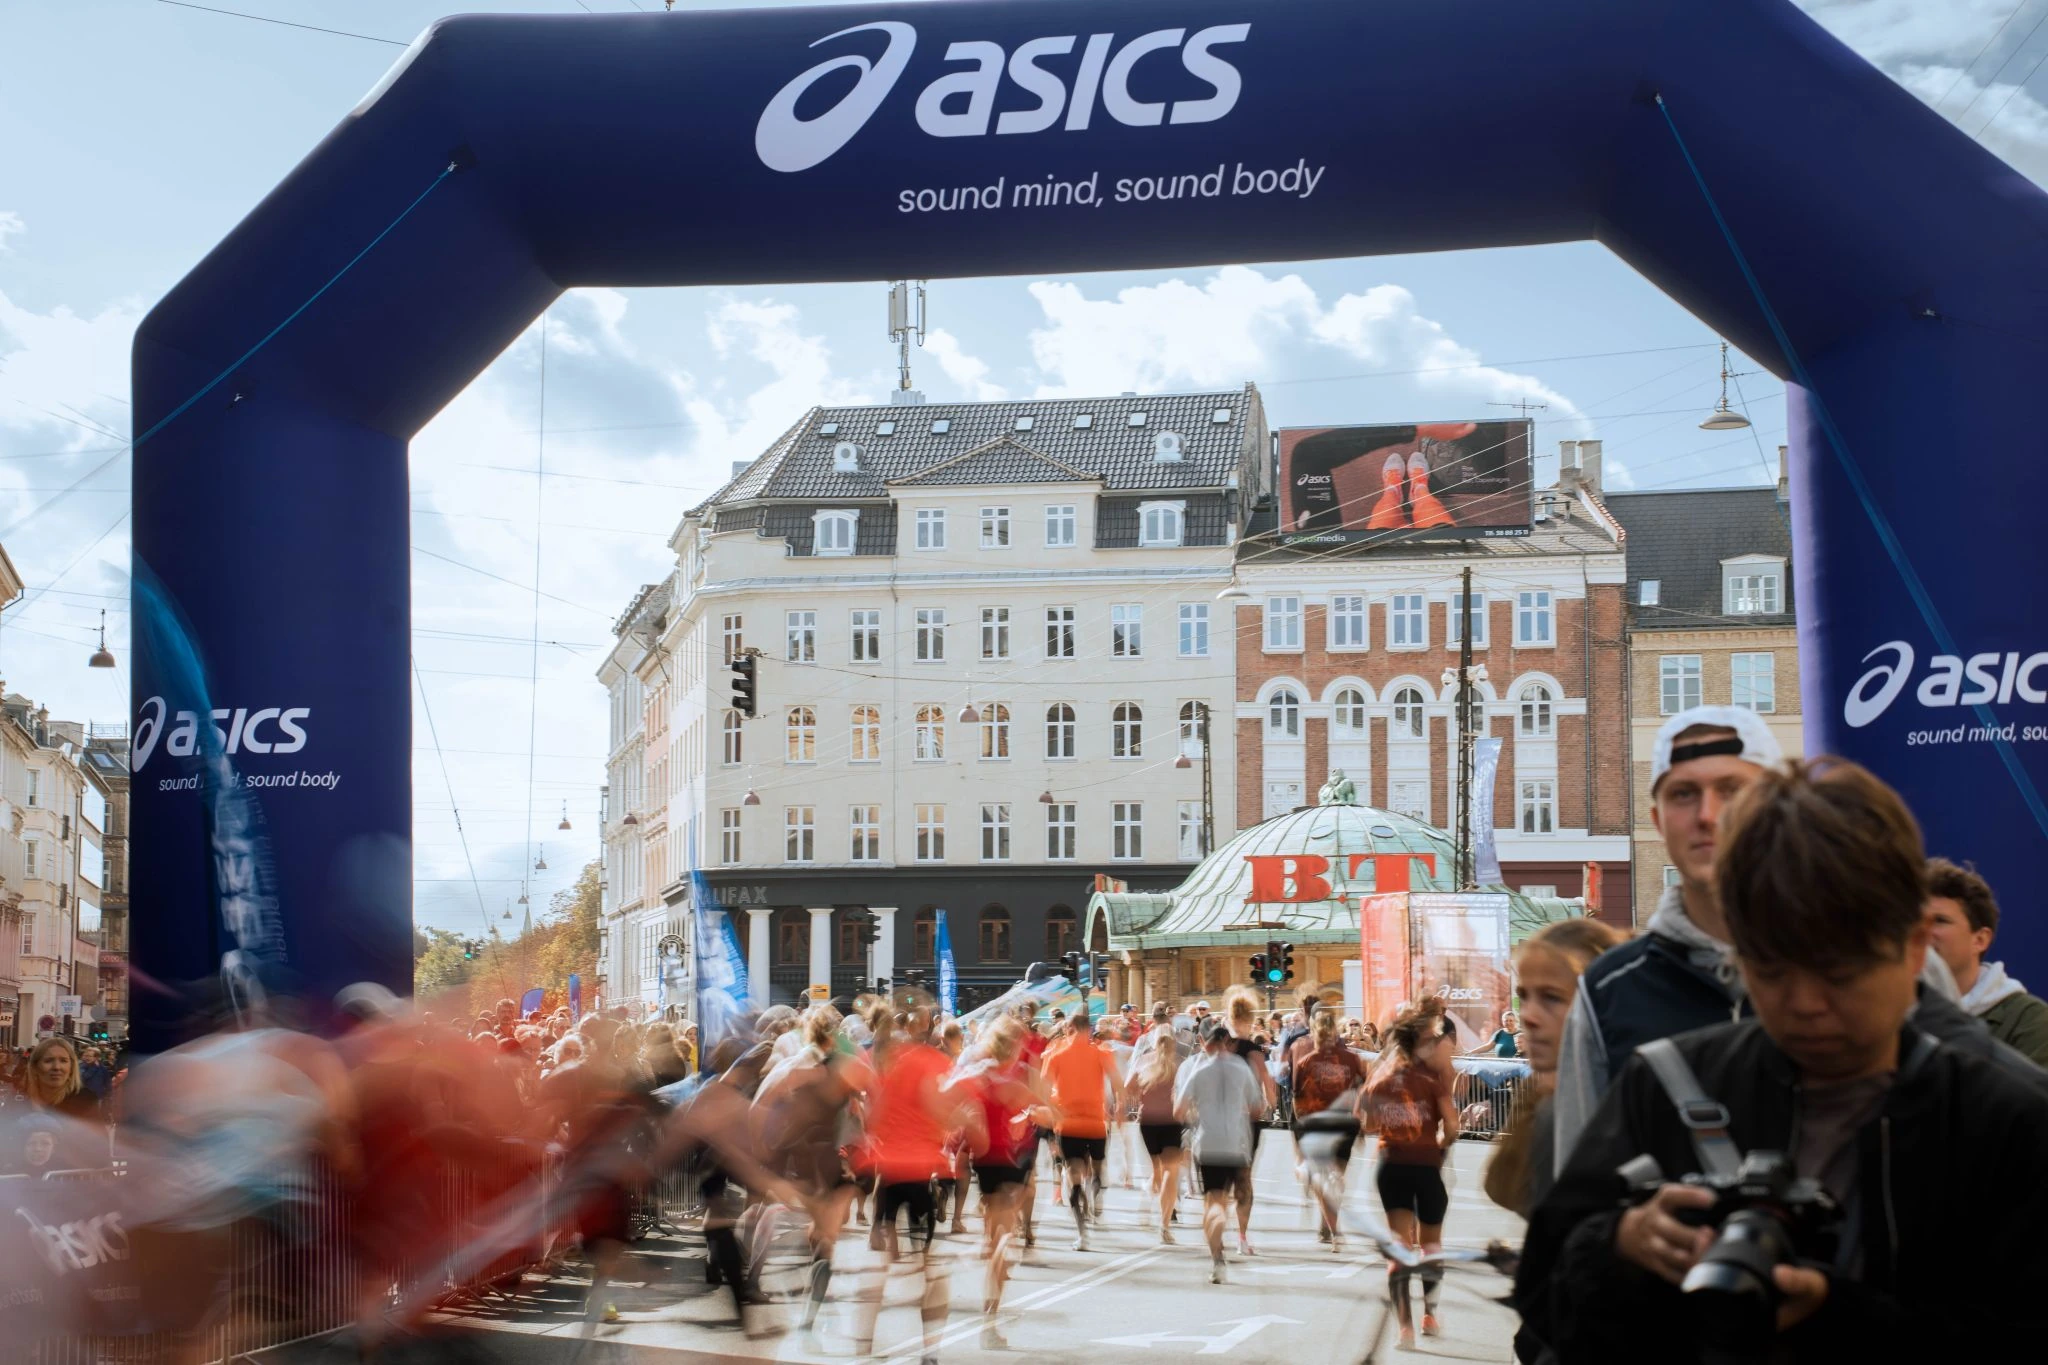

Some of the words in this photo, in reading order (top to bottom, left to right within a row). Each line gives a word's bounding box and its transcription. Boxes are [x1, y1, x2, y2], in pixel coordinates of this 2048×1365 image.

[897, 177, 1005, 213] sound
[1012, 171, 1105, 208] mind,
[1113, 164, 1225, 202] sound
[1231, 158, 1325, 198] body
[1916, 652, 2048, 707] asic
[1907, 723, 1963, 746] sound
[1968, 721, 2017, 743] mind,
[2022, 725, 2048, 741] sou
[159, 773, 198, 791] sound
[246, 771, 298, 787] sound
[299, 771, 340, 790] body
